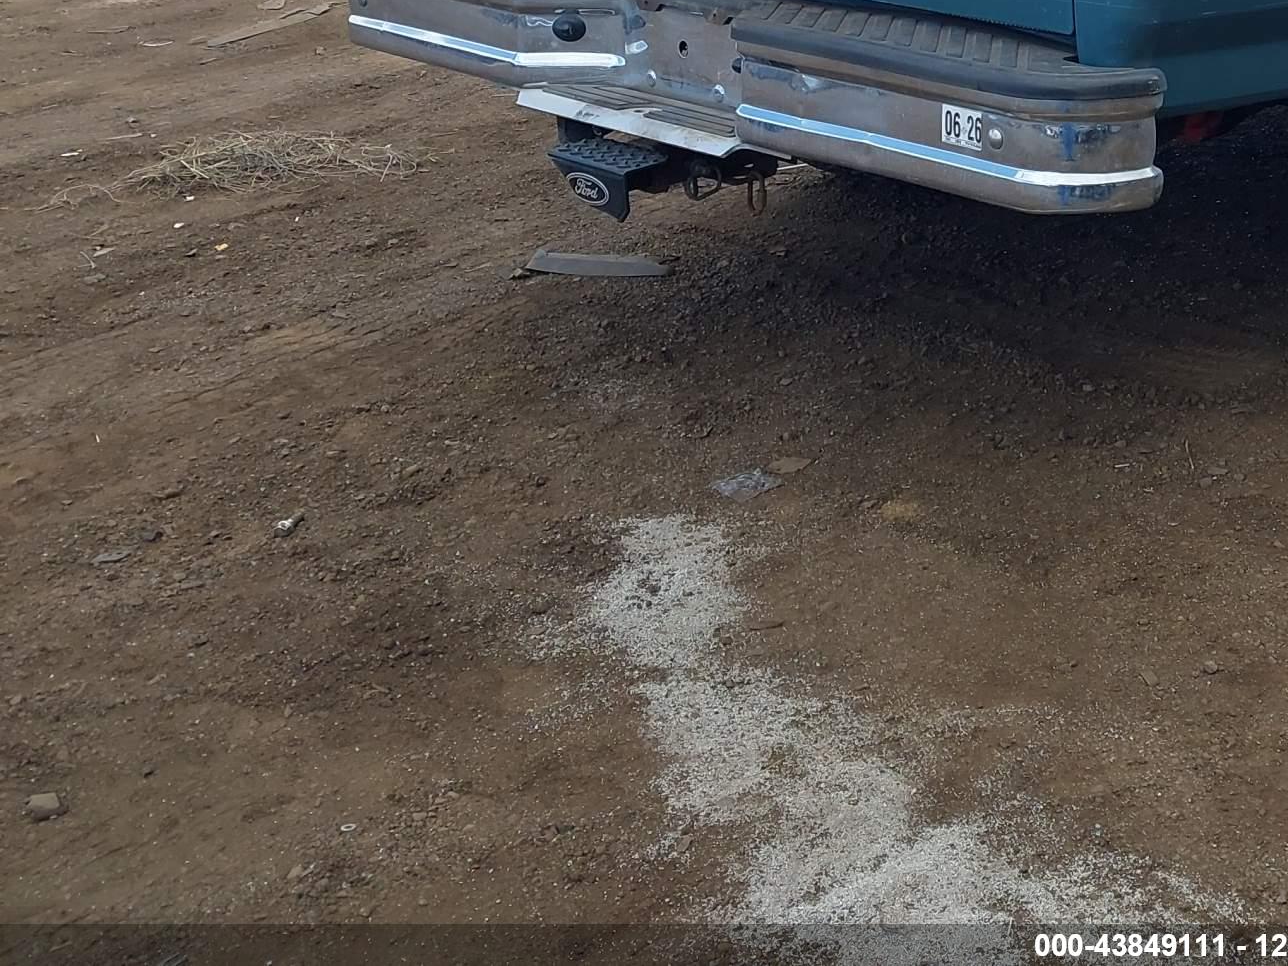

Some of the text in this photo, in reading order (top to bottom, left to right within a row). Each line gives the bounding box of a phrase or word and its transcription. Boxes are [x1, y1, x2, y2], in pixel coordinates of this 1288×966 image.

[945, 110, 961, 138] 06
[967, 115, 982, 143] 26
[574, 178, 599, 199] Ford
